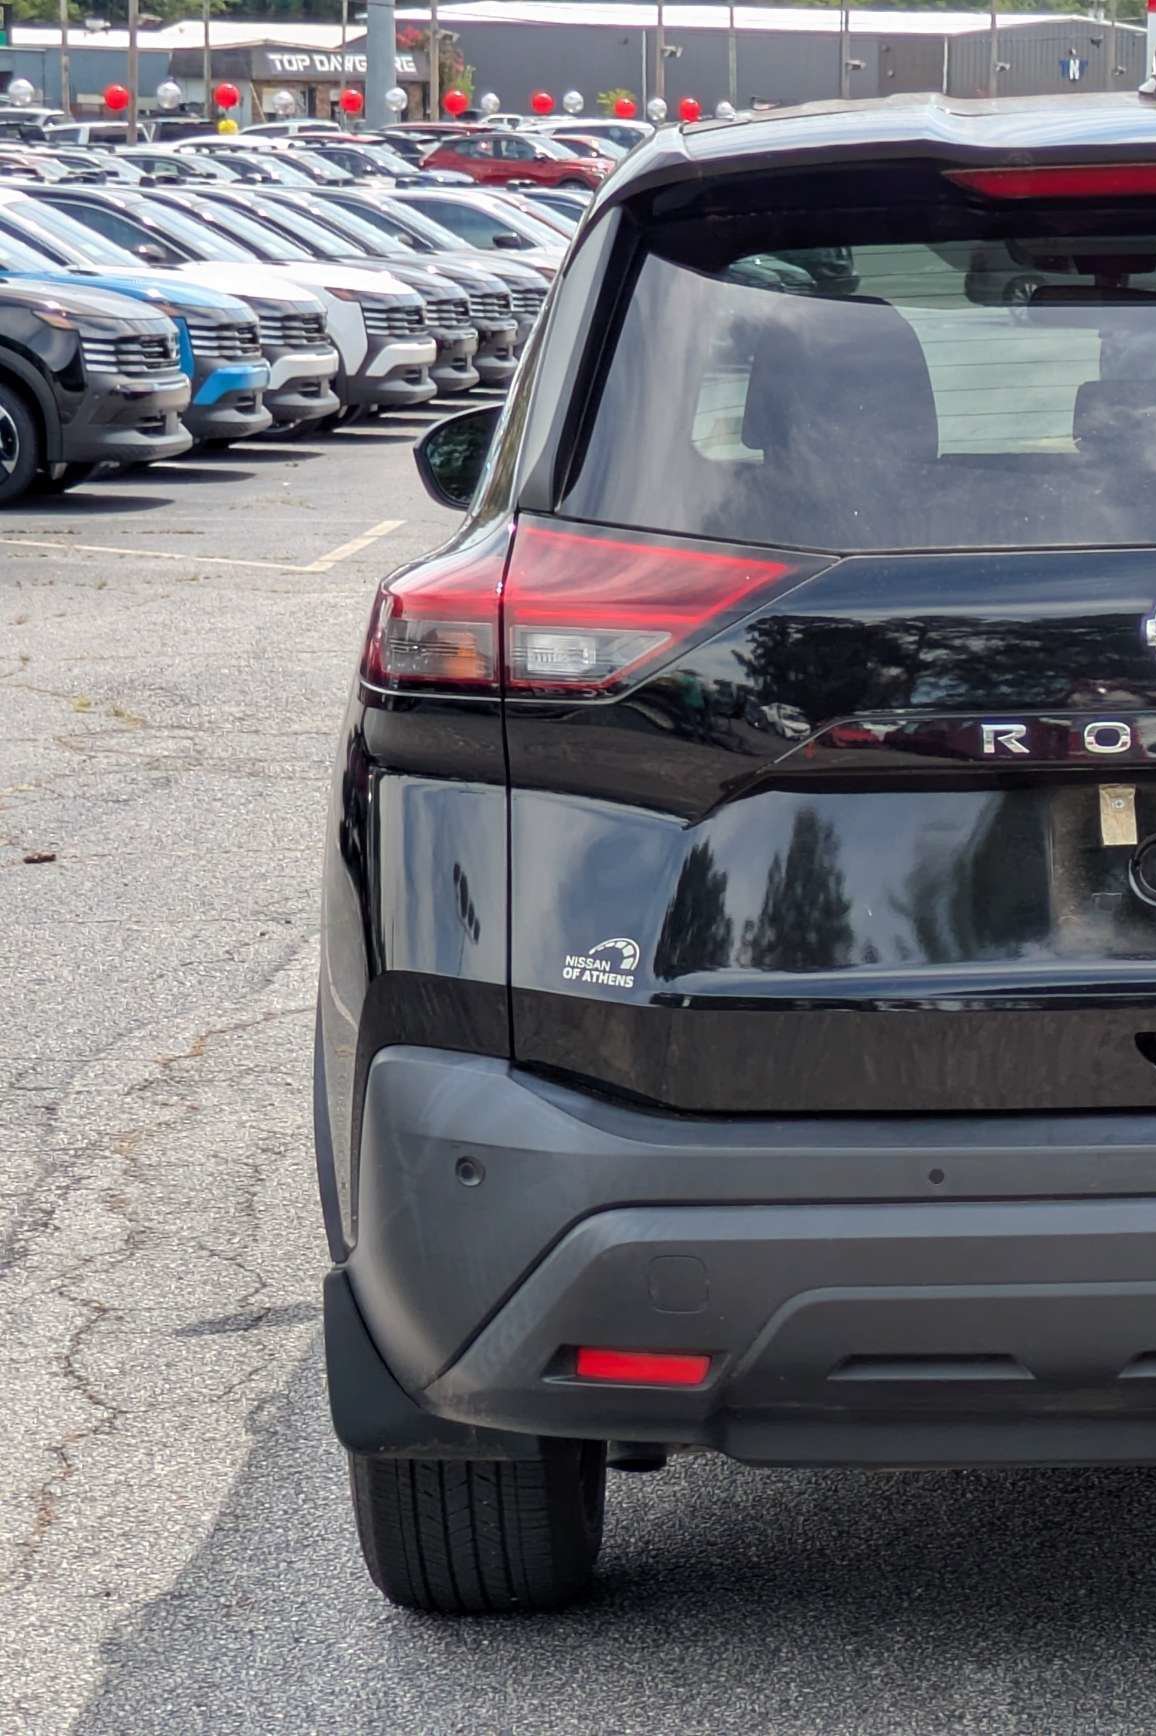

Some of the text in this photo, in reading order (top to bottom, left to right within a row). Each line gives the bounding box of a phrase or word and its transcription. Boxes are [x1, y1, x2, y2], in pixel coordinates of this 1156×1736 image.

[267, 53, 310, 71] TOP
[565, 955, 611, 972] NISSAN
[562, 966, 634, 988] OF ATHENS
